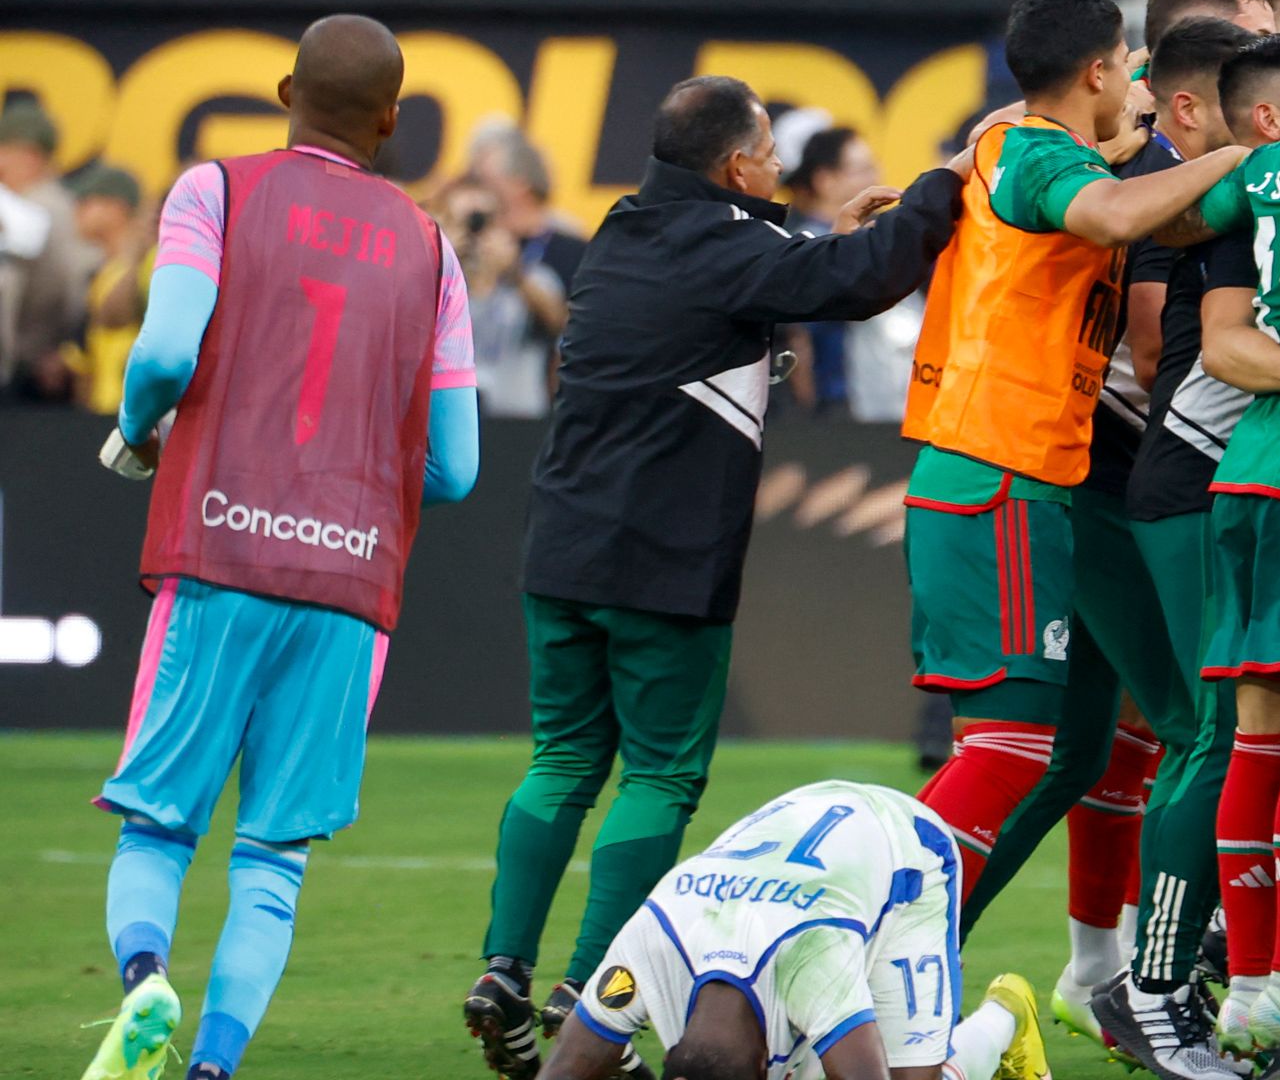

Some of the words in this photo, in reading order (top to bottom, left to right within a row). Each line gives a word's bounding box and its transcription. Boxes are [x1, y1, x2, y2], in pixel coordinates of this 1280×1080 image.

[287, 204, 398, 268] MEJIA
[294, 277, 346, 445] 1
[201, 490, 379, 561] Concacaf
[676, 873, 827, 911] FAJARDO
[890, 954, 945, 1020] 17
